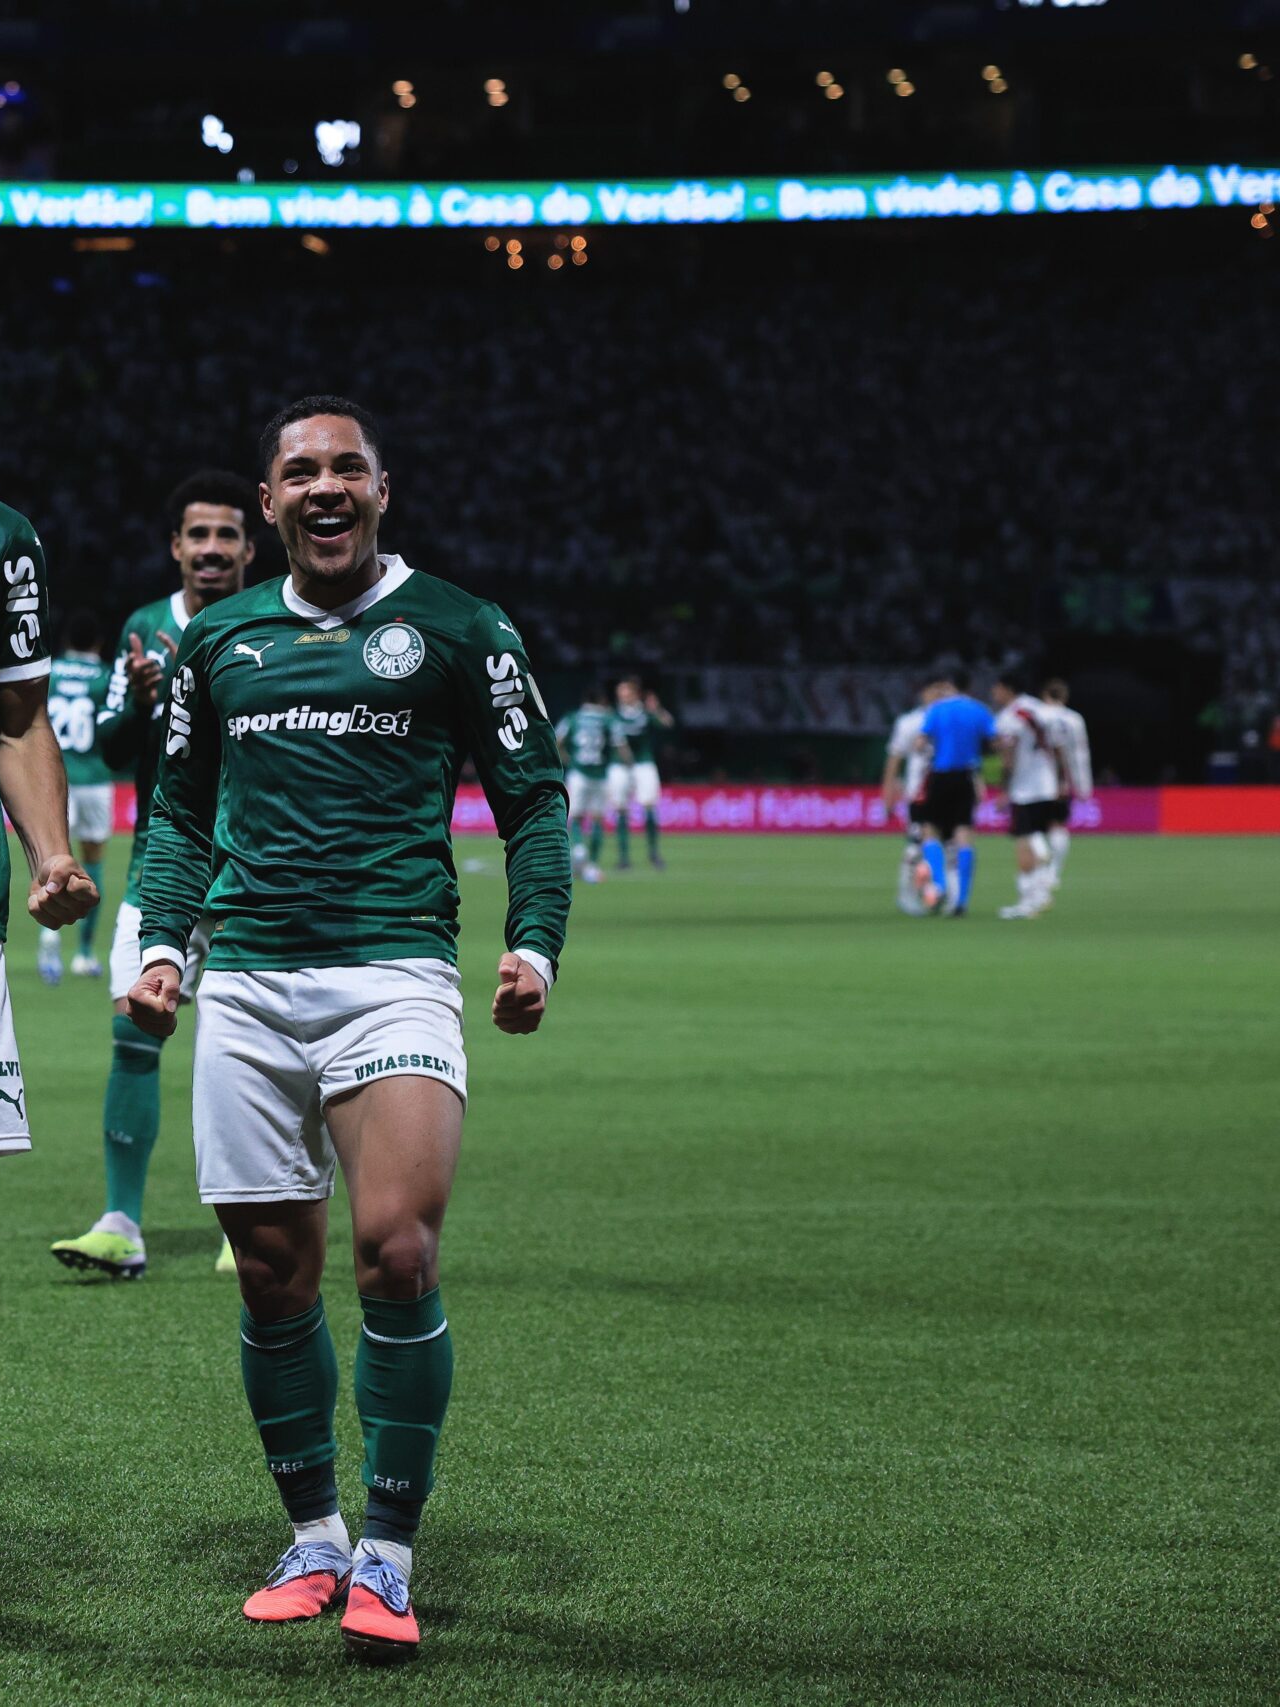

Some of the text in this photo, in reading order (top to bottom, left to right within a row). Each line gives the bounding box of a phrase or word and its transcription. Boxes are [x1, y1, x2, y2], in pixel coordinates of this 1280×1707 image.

[185, 188, 272, 226] Bem
[277, 186, 402, 226] vindos
[438, 187, 536, 225] Casa
[540, 184, 593, 225] do
[777, 180, 868, 219] Bem
[873, 175, 1003, 216] vindos
[1042, 172, 1142, 212] Casa
[1147, 166, 1202, 208] do
[367, 647, 421, 676] PALMEIRAS
[227, 704, 413, 742] sportingbet
[354, 1053, 457, 1082] UNIASSELVI
[373, 1474, 412, 1494] SEP
